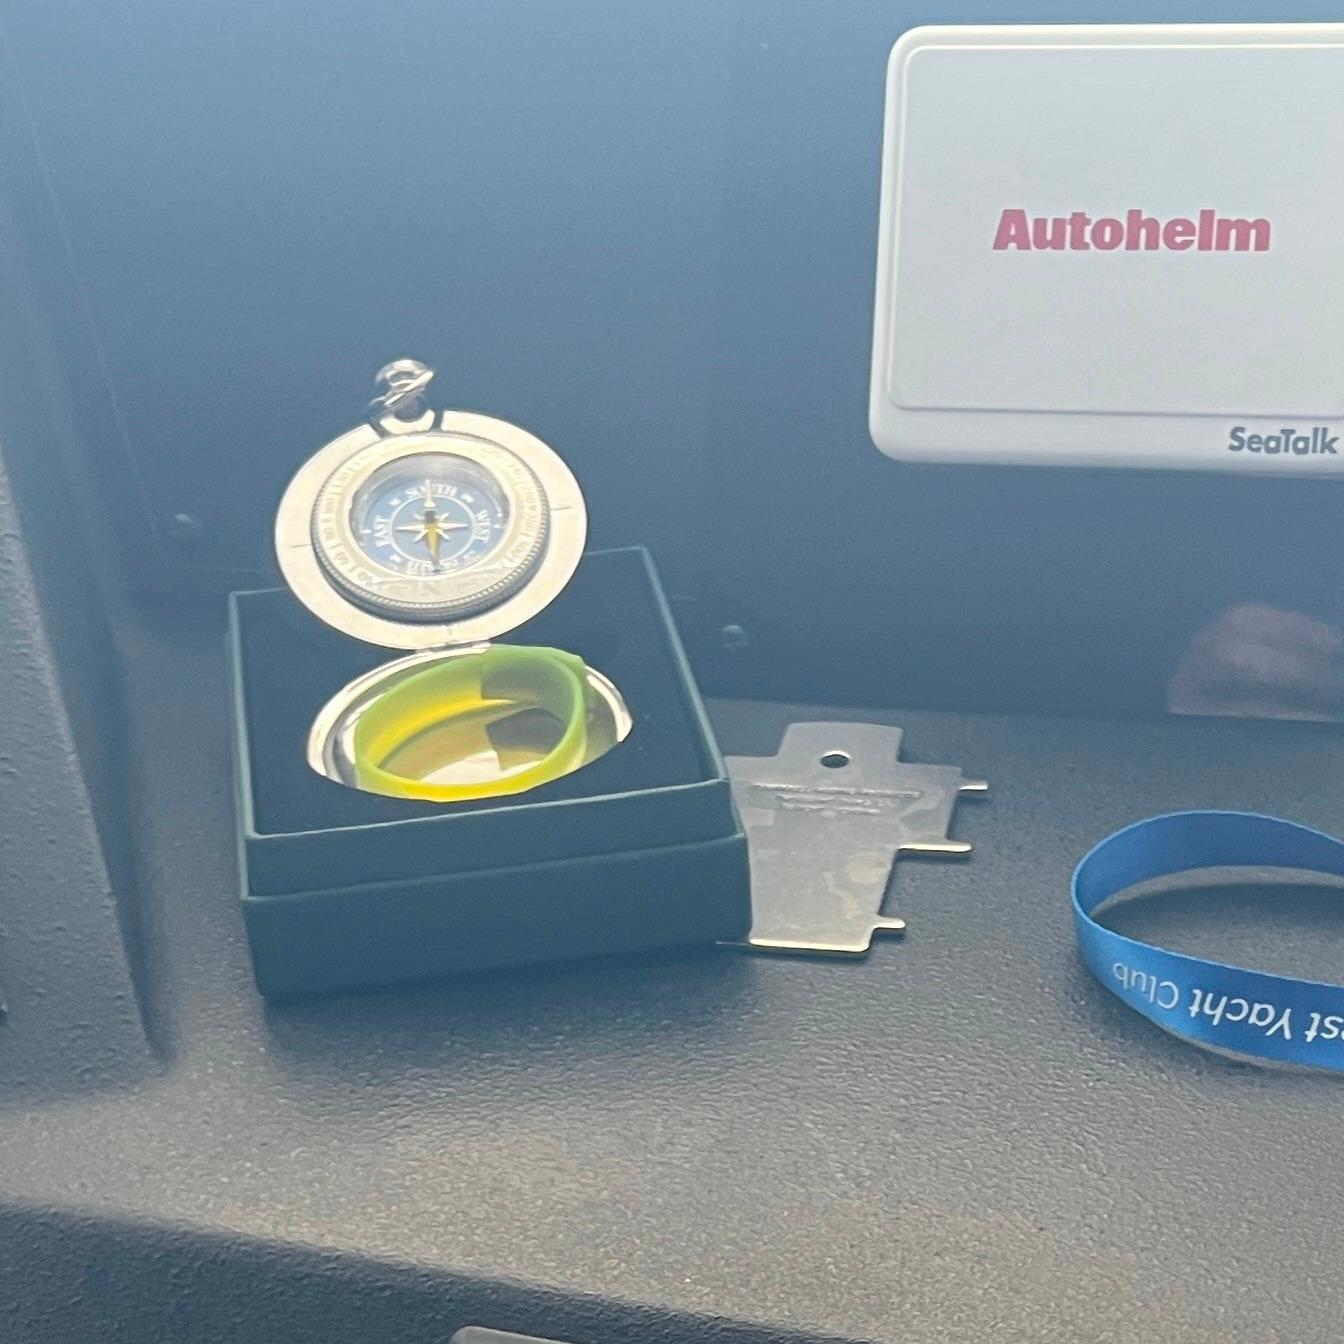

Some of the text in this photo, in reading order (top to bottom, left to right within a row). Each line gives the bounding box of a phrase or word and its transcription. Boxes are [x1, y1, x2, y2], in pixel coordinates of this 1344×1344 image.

[992, 208, 1272, 252] Autohelm
[1227, 426, 1339, 456] SeaTalk
[1112, 962, 1180, 1010] Club
[1188, 988, 1292, 1041] Yacht
